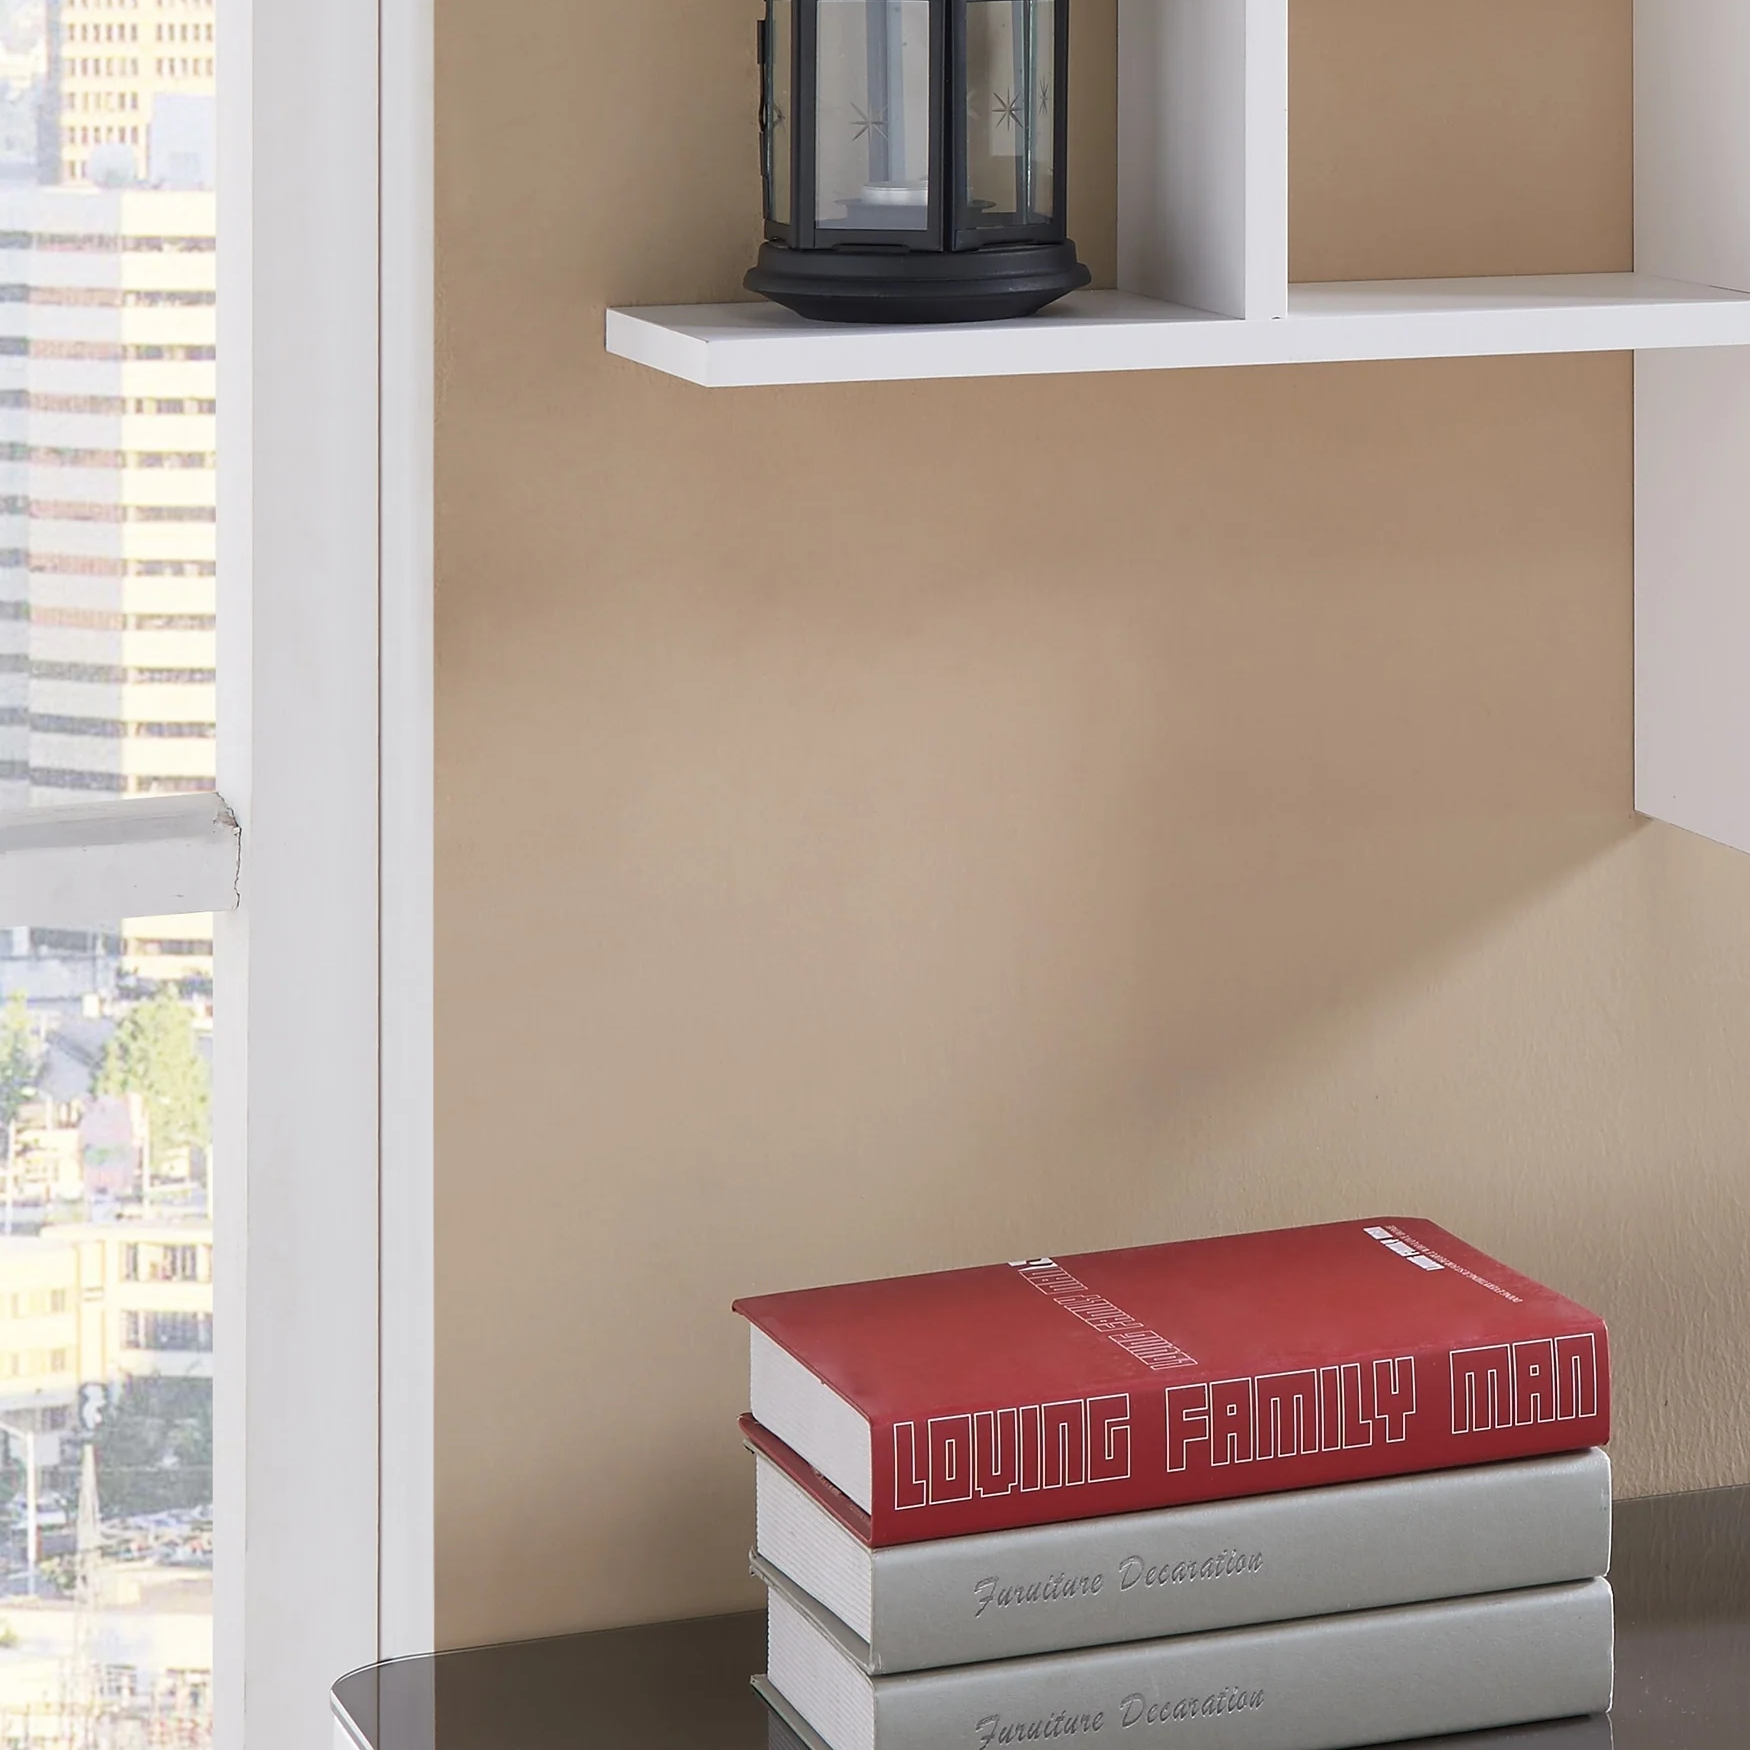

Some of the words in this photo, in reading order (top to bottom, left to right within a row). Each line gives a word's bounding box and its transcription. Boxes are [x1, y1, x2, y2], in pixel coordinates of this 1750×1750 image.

[893, 1393, 1131, 1510] LOVING
[1165, 1356, 1415, 1473] FAMILY
[1449, 1333, 1597, 1434] MAN
